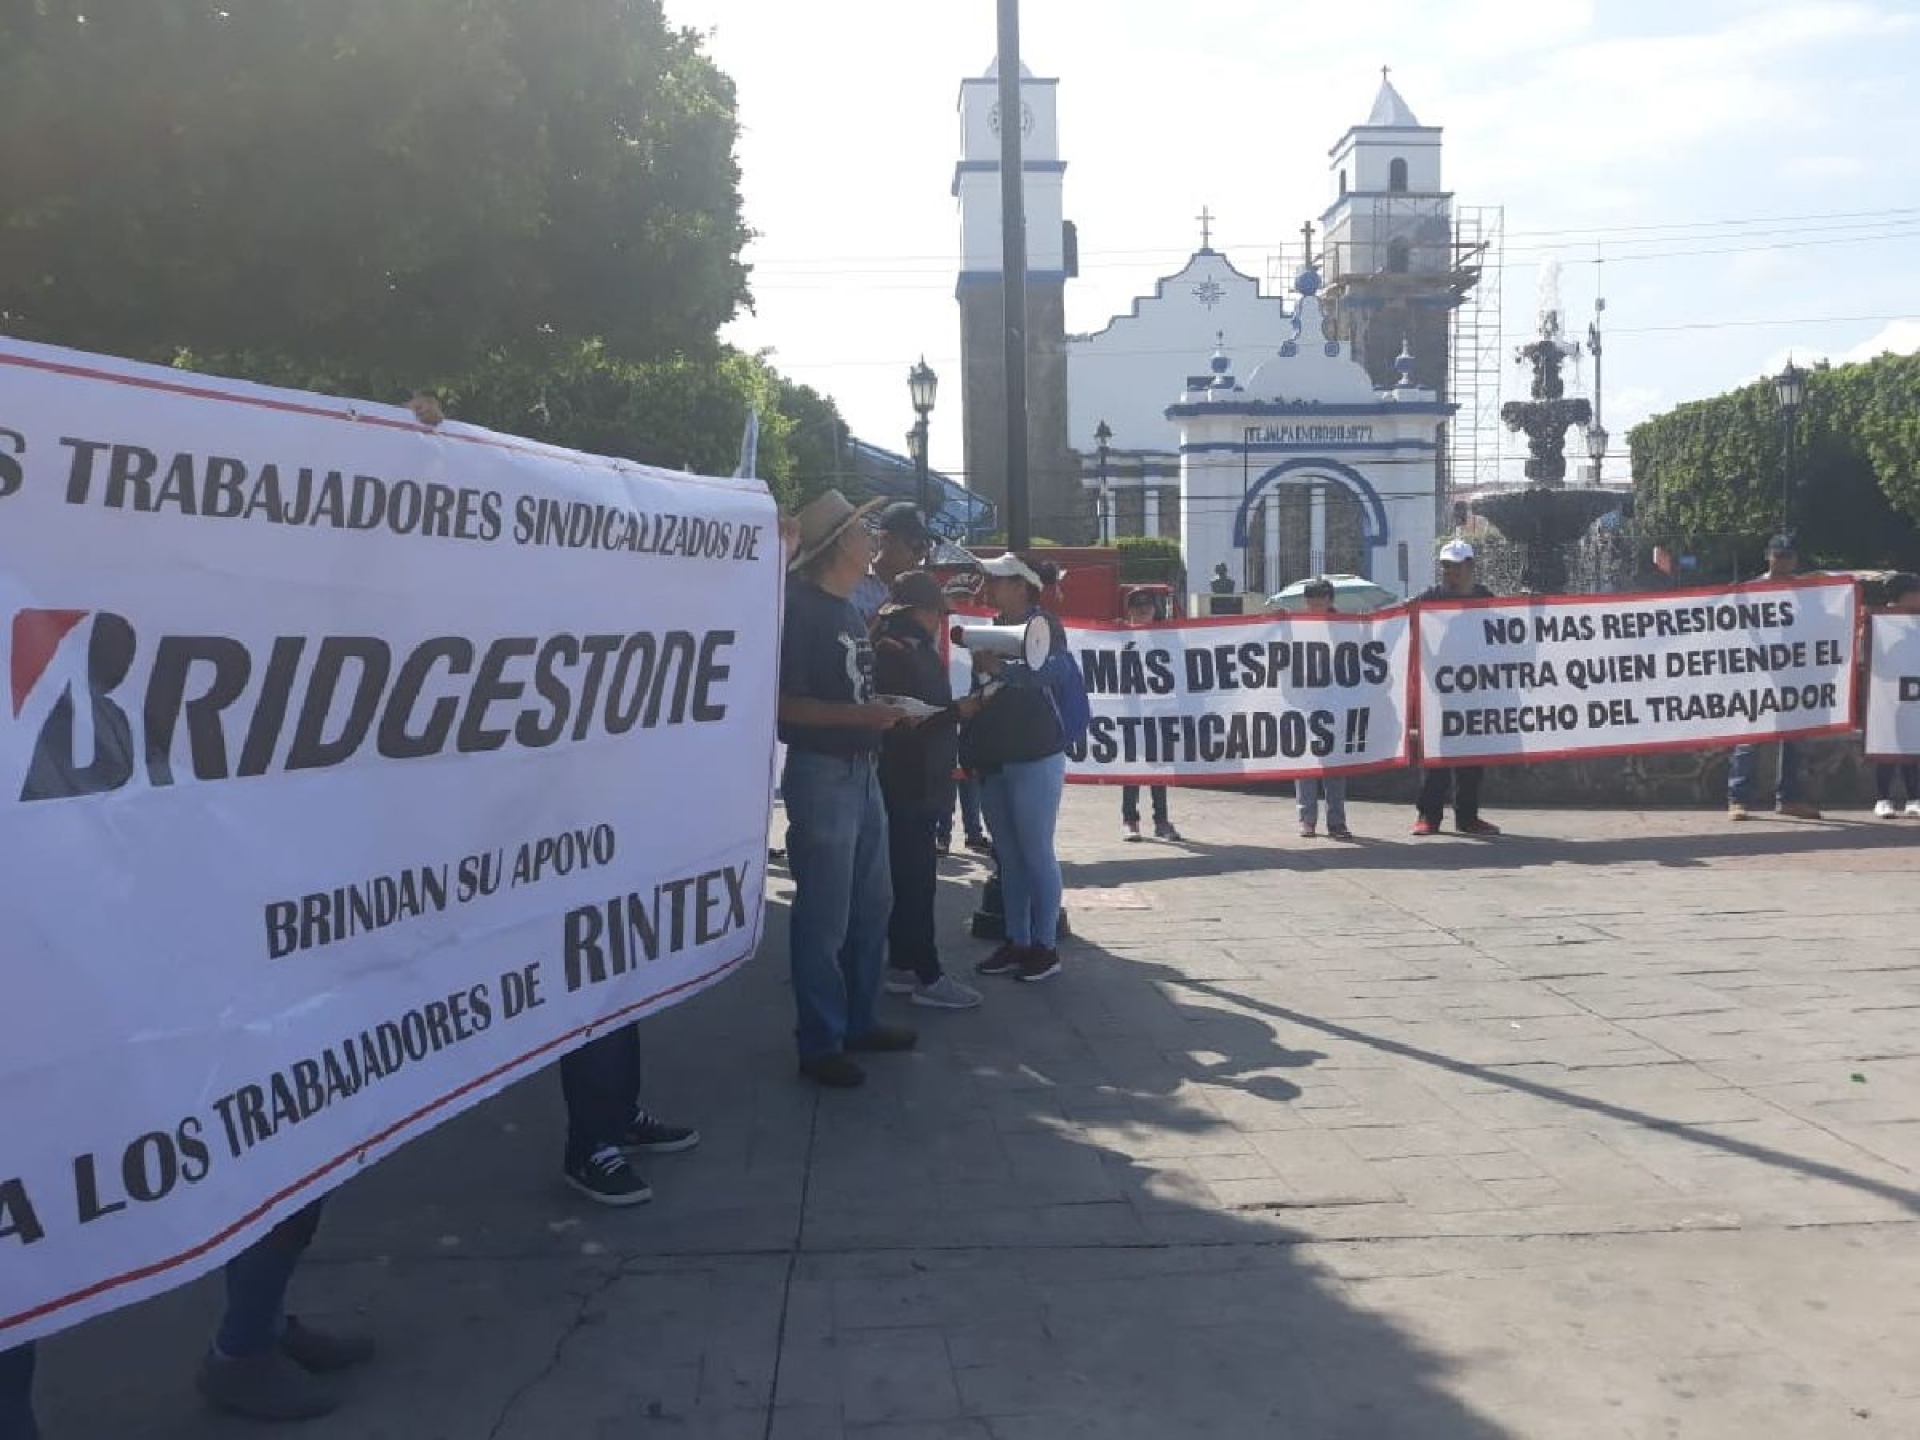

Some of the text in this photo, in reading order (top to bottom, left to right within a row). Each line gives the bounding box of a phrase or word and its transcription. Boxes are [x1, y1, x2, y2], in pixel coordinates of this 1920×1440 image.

[59, 437, 502, 541] TRABAJADORES
[514, 495, 731, 560] SINDICALIZADOS
[733, 525, 762, 560] DE
[1081, 641, 1388, 694] MÁS DESPIDOS
[1435, 639, 1843, 694] CONTRA QUIEN DEFIENDE EL
[1484, 602, 1794, 645] NO MAS REPRESIONES
[11, 608, 735, 802] BRIDGESTONE
[1442, 684, 1836, 737] DERECHO DEL TRABAJADOR
[265, 823, 615, 959] BRINDAN SU APOYO
[0, 861, 748, 1245] A LOS TRABAJADORES DE RINTEX
